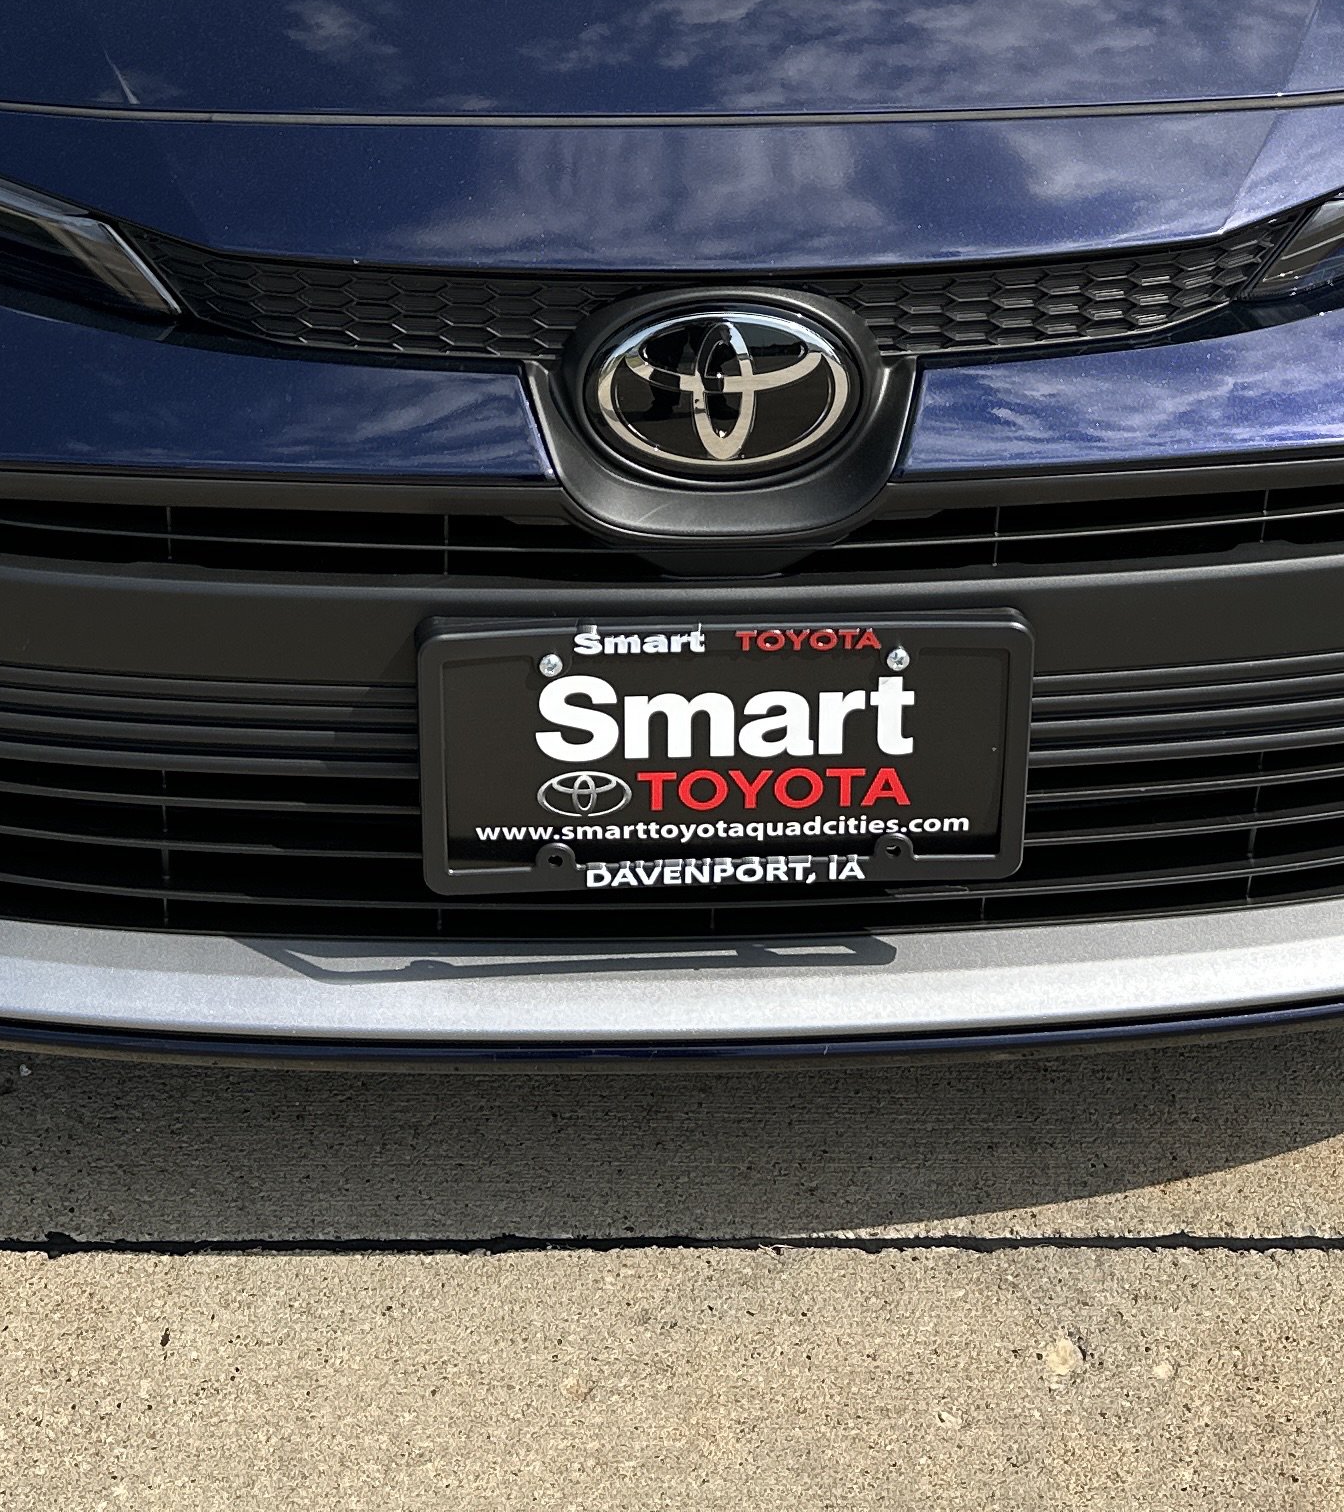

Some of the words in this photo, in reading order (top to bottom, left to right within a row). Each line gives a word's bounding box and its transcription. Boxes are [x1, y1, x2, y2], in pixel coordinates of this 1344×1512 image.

[572, 624, 706, 655] Smart
[735, 628, 882, 652] TOYOTA
[535, 675, 915, 762] Smart
[636, 767, 911, 812] TOYOTA
[475, 813, 970, 844] www.smarttoyotaquadcities.com
[585, 856, 817, 888] DAVENPORT,
[828, 855, 865, 881] IA
